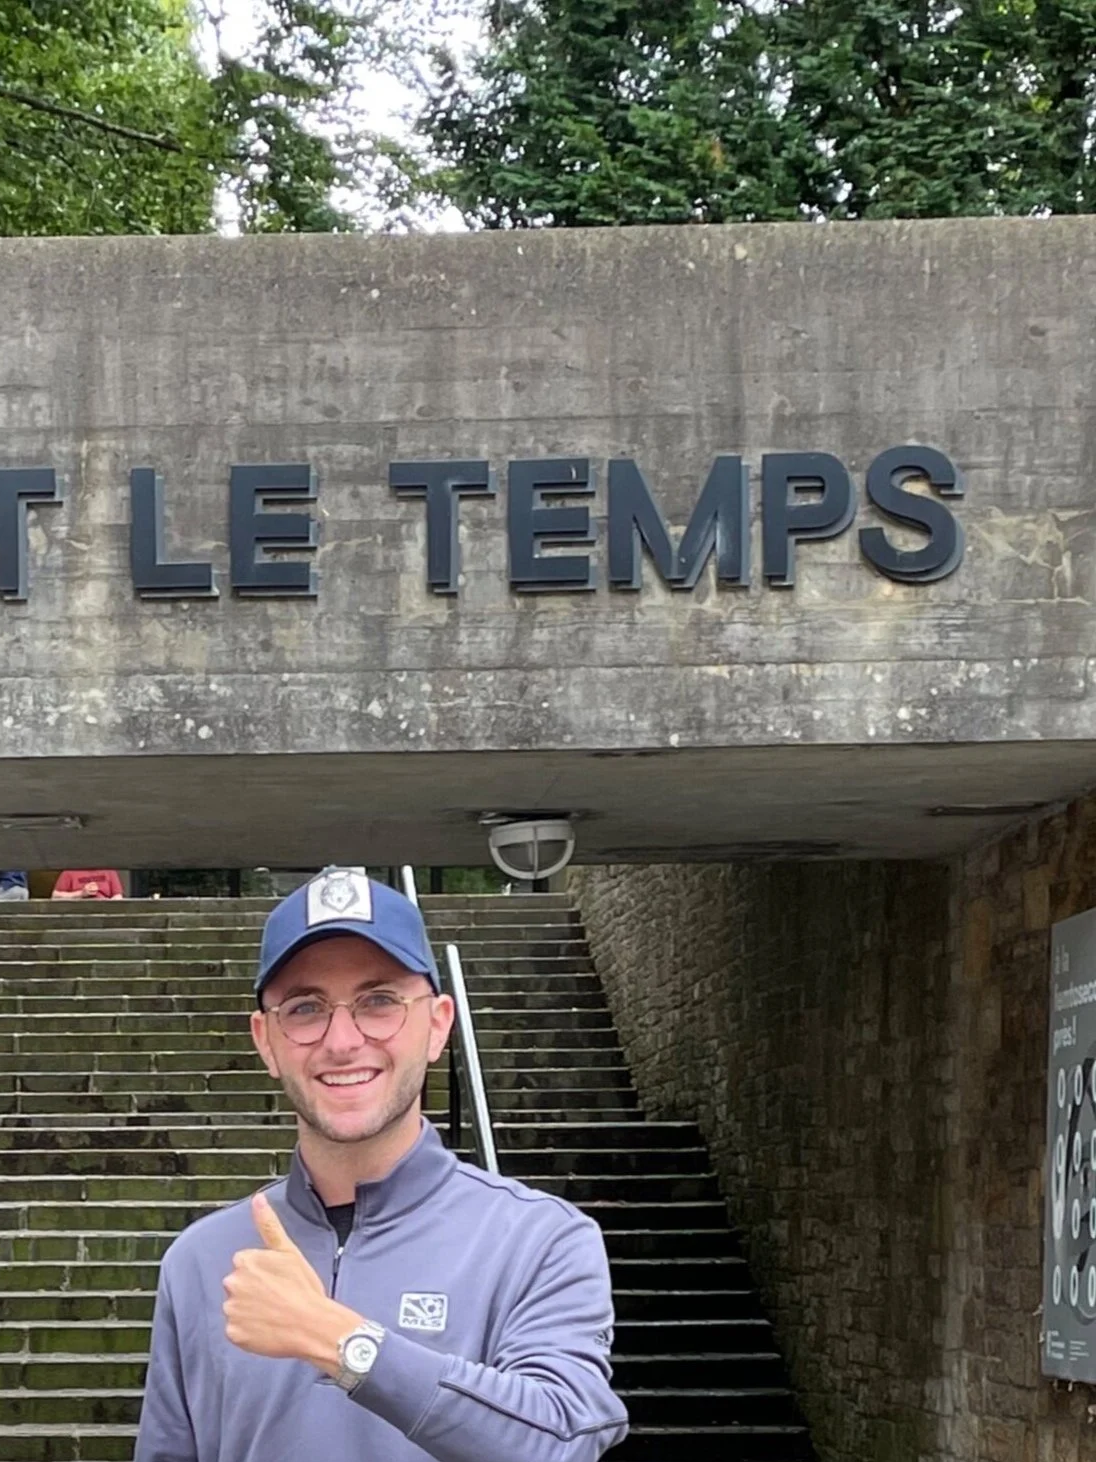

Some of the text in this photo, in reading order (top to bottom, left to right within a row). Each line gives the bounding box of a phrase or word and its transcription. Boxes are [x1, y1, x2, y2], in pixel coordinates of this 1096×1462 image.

[131, 463, 318, 600] LE
[389, 444, 964, 592] TEMPS
[402, 1317, 442, 1328] MLS
